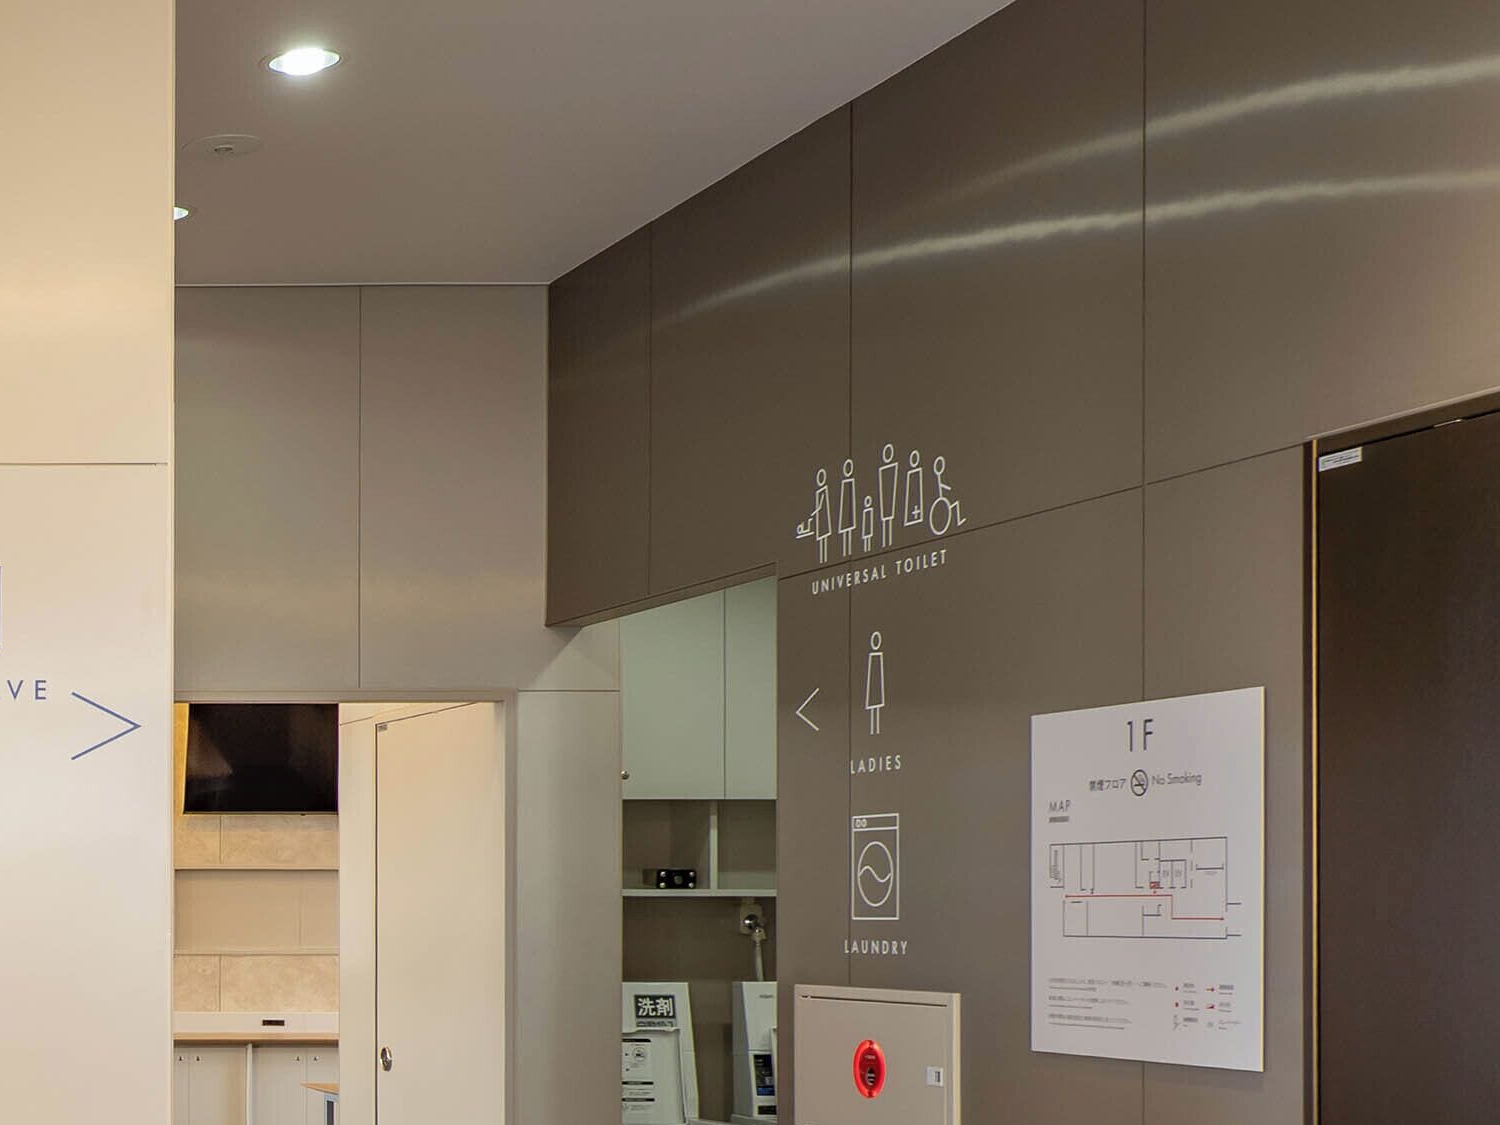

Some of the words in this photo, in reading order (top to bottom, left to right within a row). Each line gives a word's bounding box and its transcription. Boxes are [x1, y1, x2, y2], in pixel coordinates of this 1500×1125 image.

[812, 565, 887, 595] UNIVERSAL
[895, 549, 948, 576] TOILET
[1125, 718, 1154, 753] 1F
[850, 754, 902, 775] LADIES
[1152, 775, 1165, 786] No
[1167, 772, 1202, 787] Smoking
[1048, 799, 1071, 813] MAP
[844, 939, 908, 956] LAUNDRY
[638, 998, 674, 1017] 洗剤
